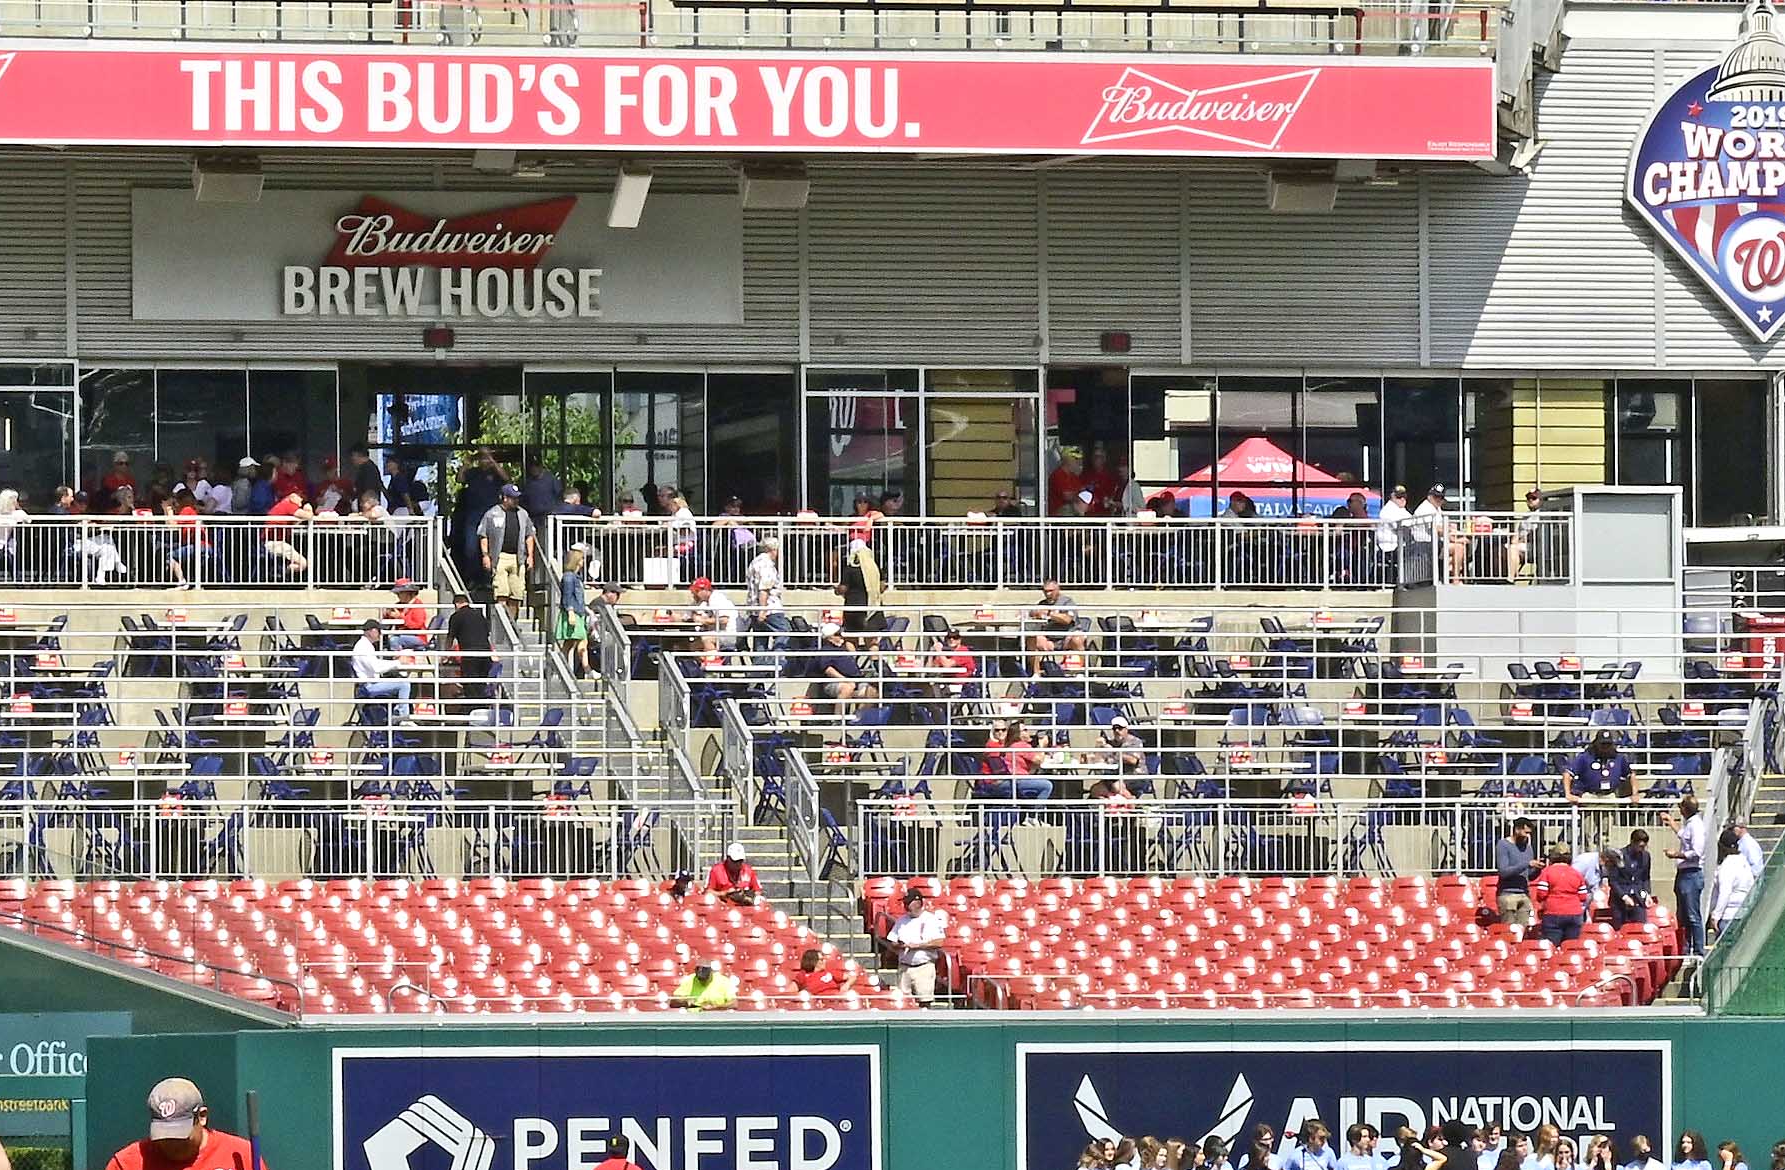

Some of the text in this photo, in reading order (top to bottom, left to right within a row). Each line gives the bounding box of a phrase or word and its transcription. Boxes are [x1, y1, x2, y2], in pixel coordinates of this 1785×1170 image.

[181, 59, 921, 139] THIS BUD'S FOR YOU.
[1101, 82, 1300, 126] Budweiser
[336, 213, 555, 259] Budweiser
[283, 265, 603, 319] BREW HOUSE
[1431, 1096, 1616, 1131] NATIONAL
